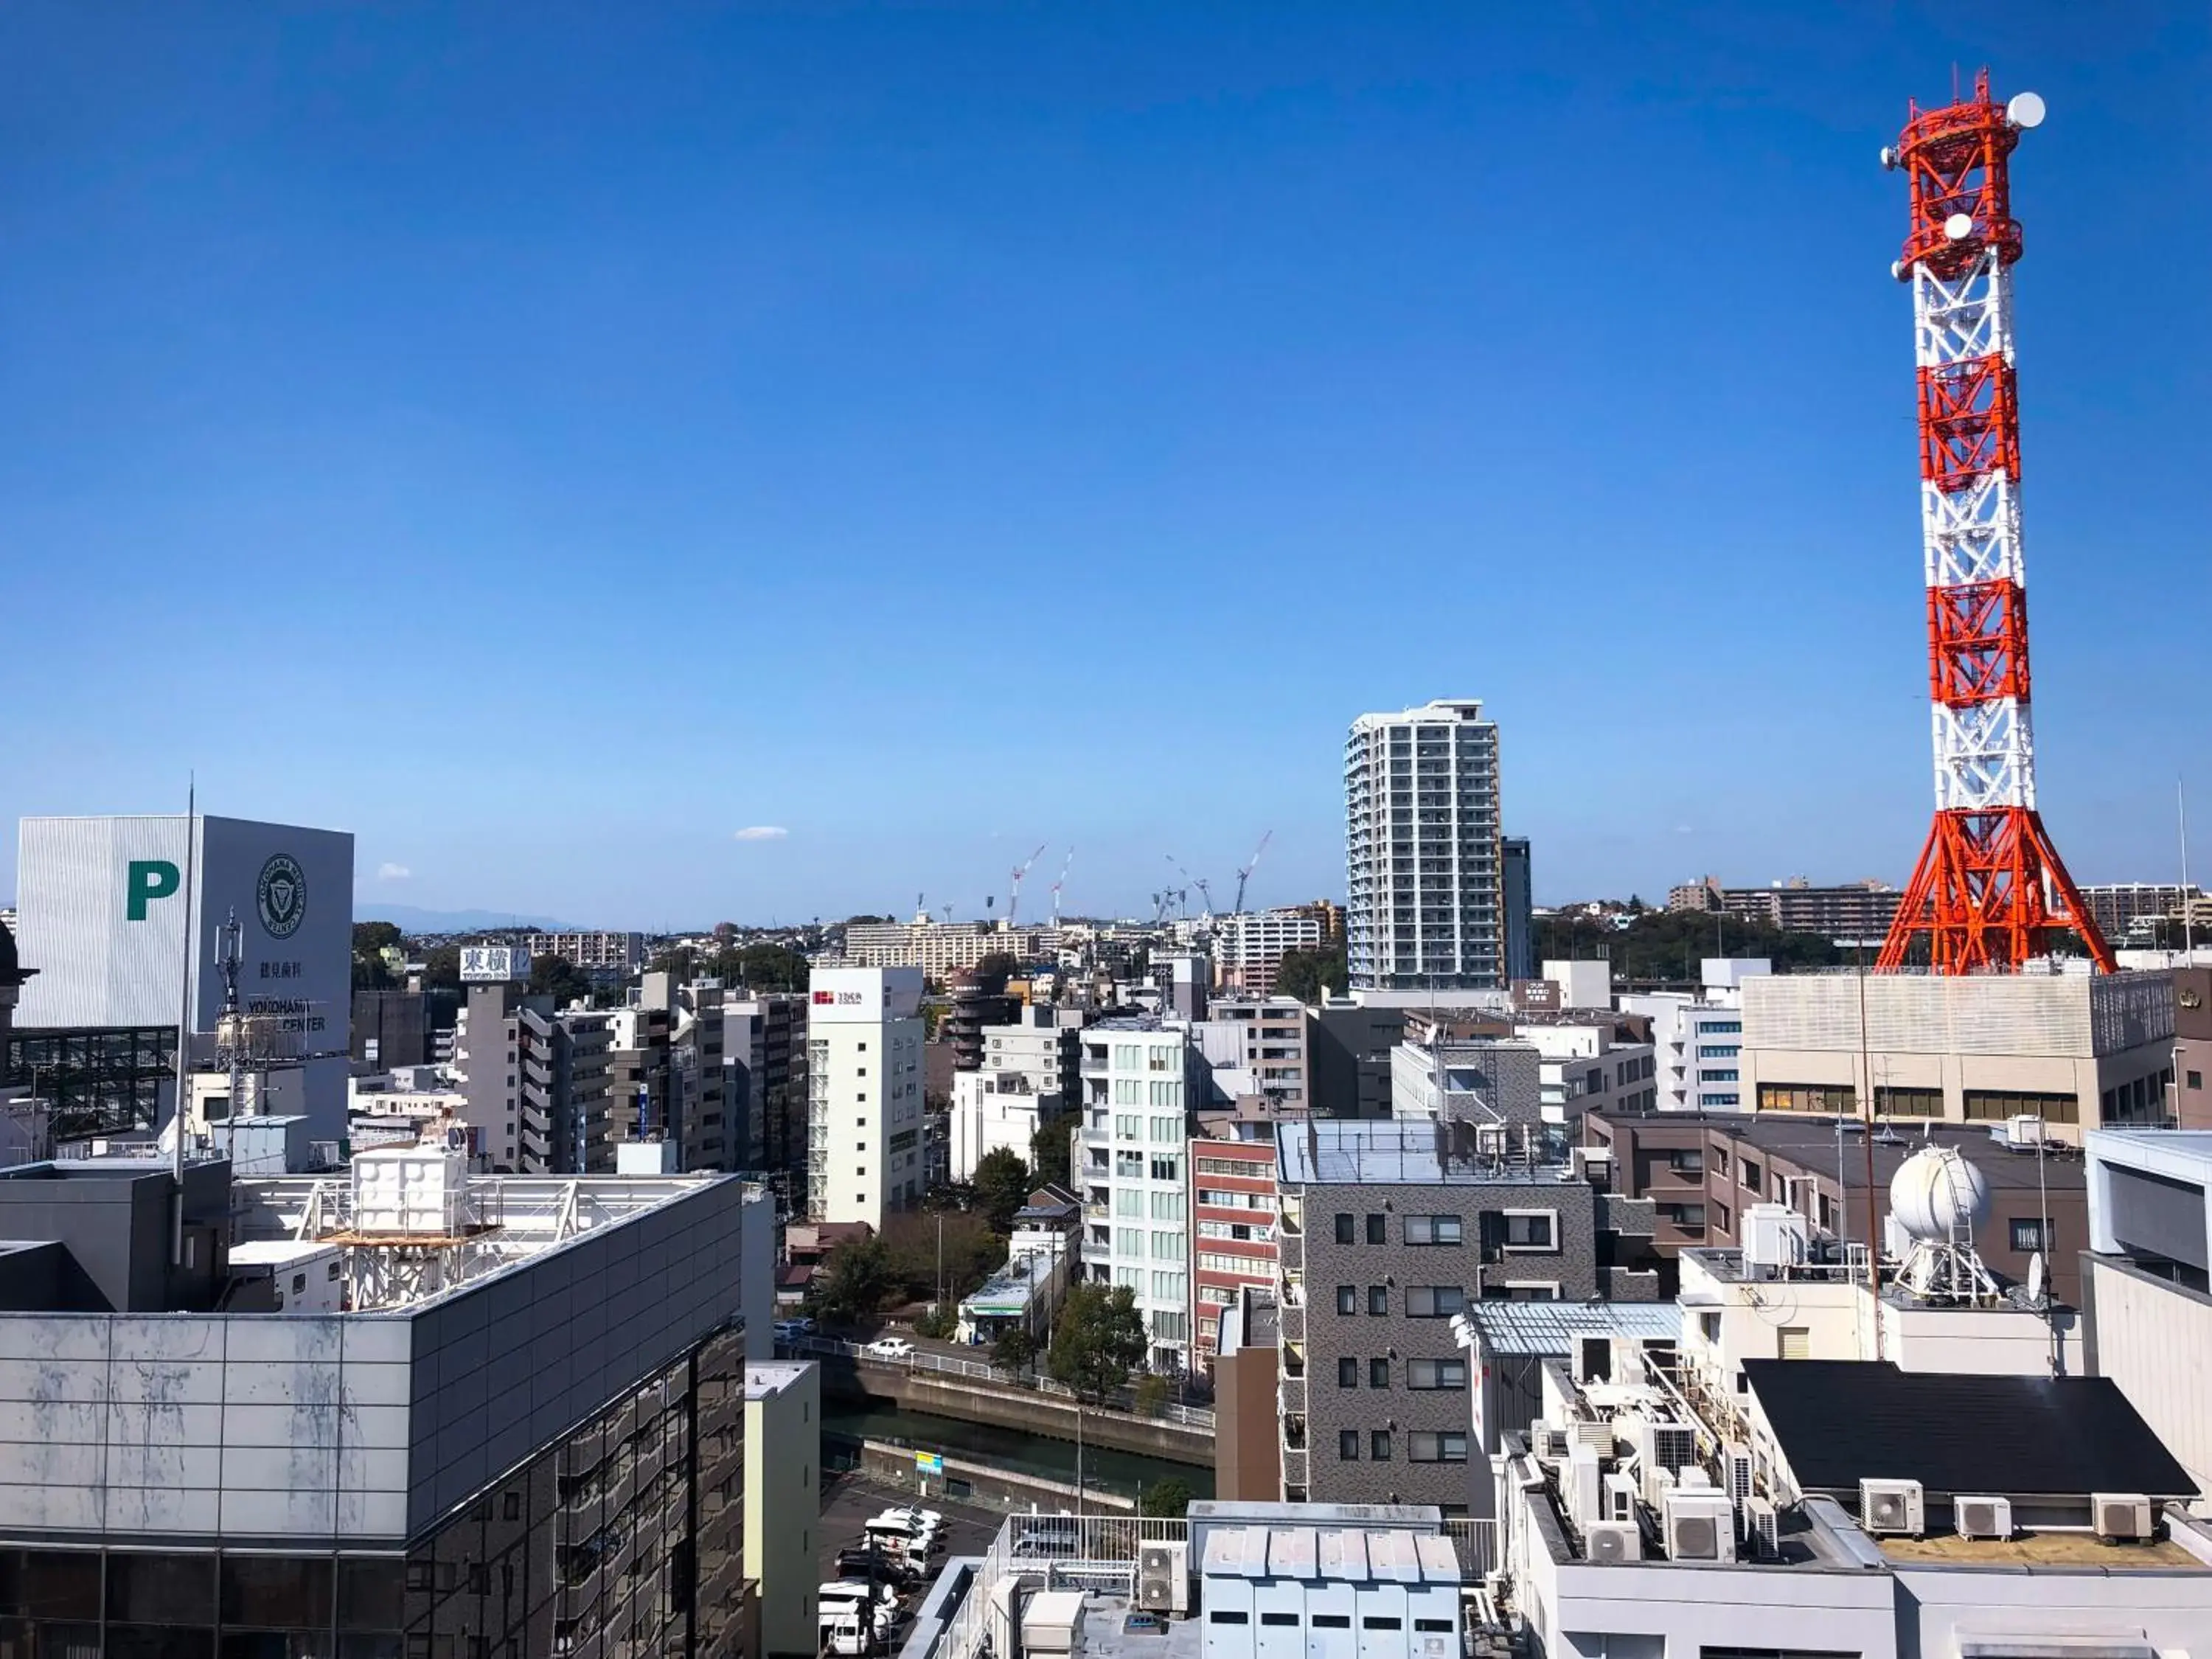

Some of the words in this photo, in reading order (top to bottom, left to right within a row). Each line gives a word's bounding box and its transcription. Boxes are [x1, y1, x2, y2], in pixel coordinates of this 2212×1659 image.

[127, 860, 181, 921] P
[248, 1000, 311, 1015] YOKOHAMA
[282, 1017, 325, 1032] CENTER
